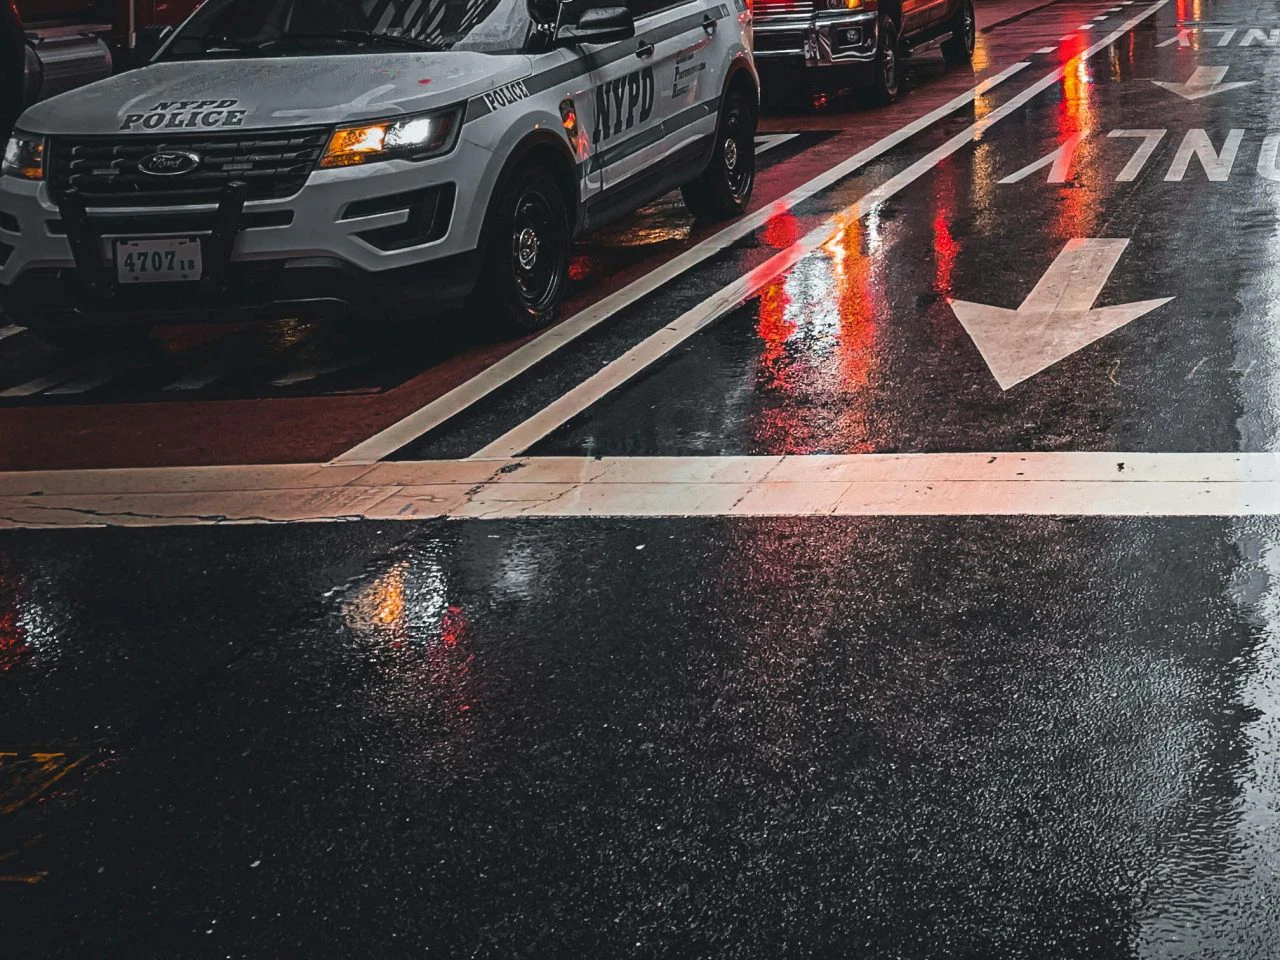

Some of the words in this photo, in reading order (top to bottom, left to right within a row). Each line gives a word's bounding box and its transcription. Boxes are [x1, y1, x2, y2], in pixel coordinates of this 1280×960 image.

[150, 99, 240, 111] NYPD
[487, 80, 529, 110] POLICE
[592, 67, 655, 144] NYPD
[119, 110, 247, 132] POLICE
[147, 153, 184, 169] Ford
[124, 250, 177, 273] 4707
[180, 259, 195, 272] 18
